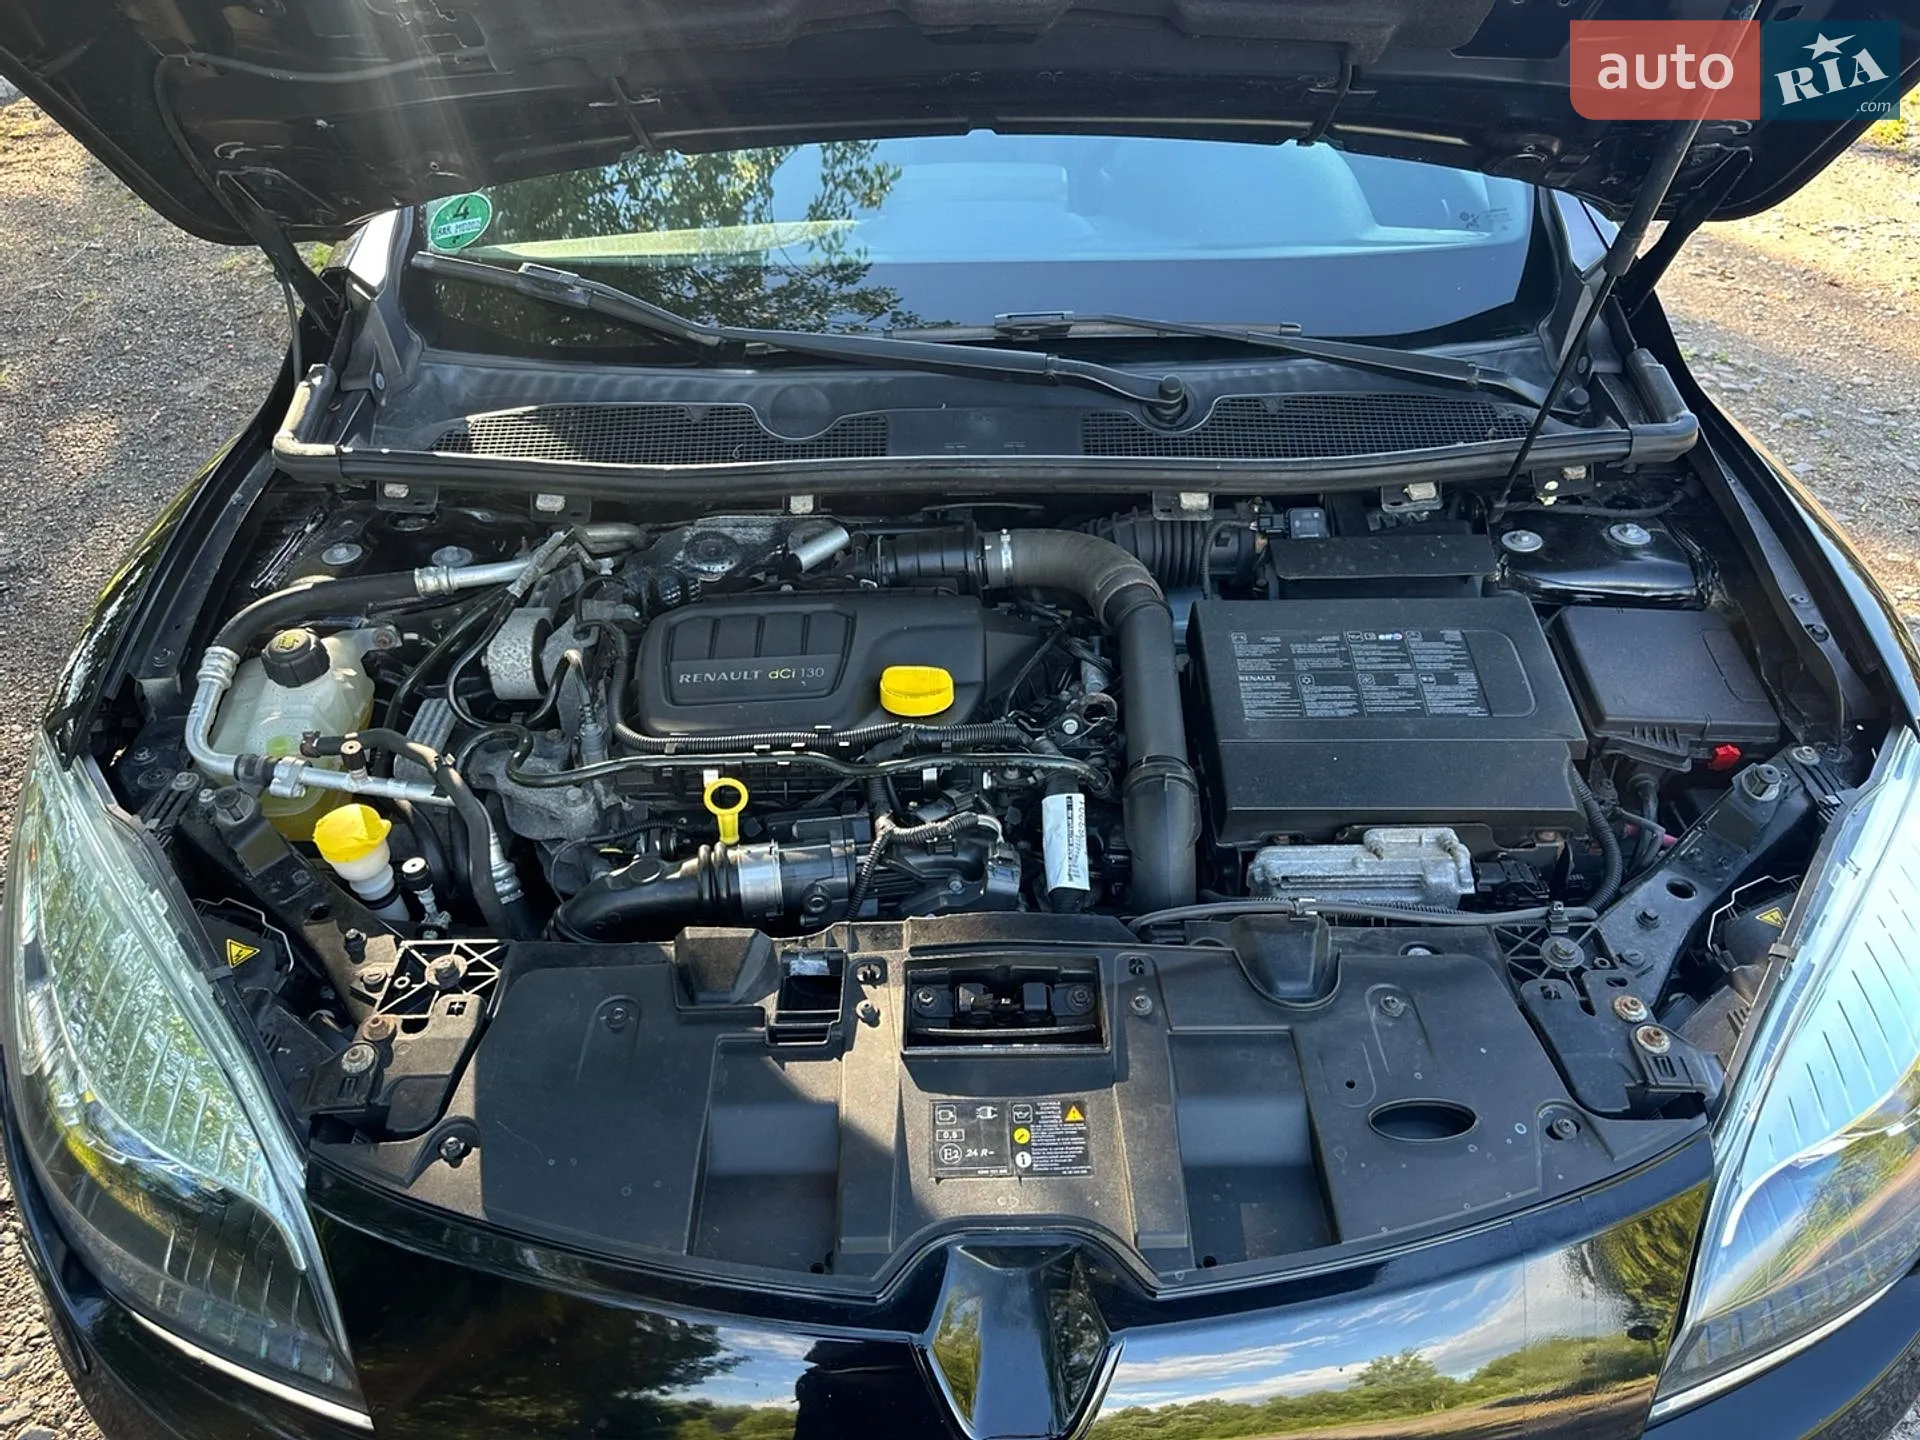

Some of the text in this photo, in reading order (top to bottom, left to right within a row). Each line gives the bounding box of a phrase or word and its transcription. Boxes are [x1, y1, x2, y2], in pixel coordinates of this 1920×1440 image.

[453, 196, 470, 219] 4
[679, 667, 825, 684] RENAULT dCi 130
[943, 1148, 960, 1161] E2
